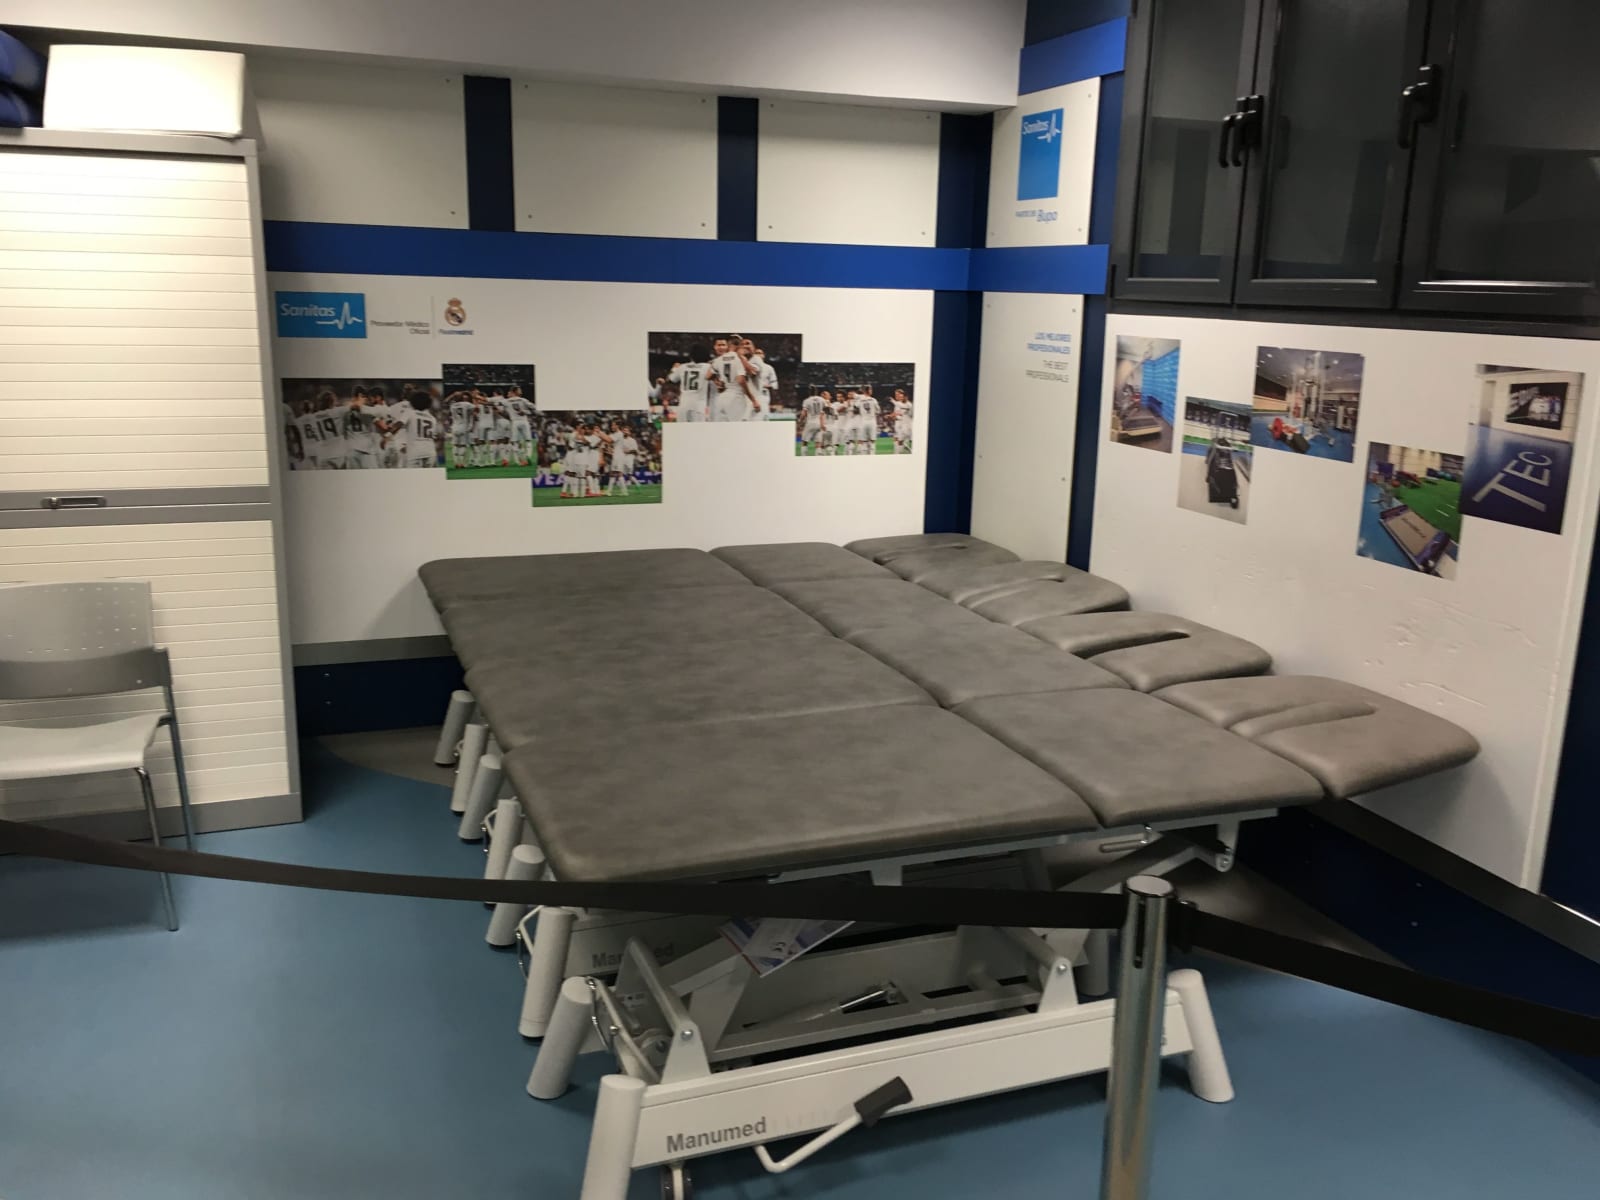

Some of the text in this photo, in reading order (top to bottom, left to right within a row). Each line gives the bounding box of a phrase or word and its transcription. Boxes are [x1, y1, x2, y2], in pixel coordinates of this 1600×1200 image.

[280, 303, 337, 317] Sanitas
[684, 370, 699, 391] 12
[316, 417, 339, 441] 19
[417, 418, 433, 439] 12
[1471, 451, 1553, 512] TEC
[665, 1115, 767, 1154] Manumed
